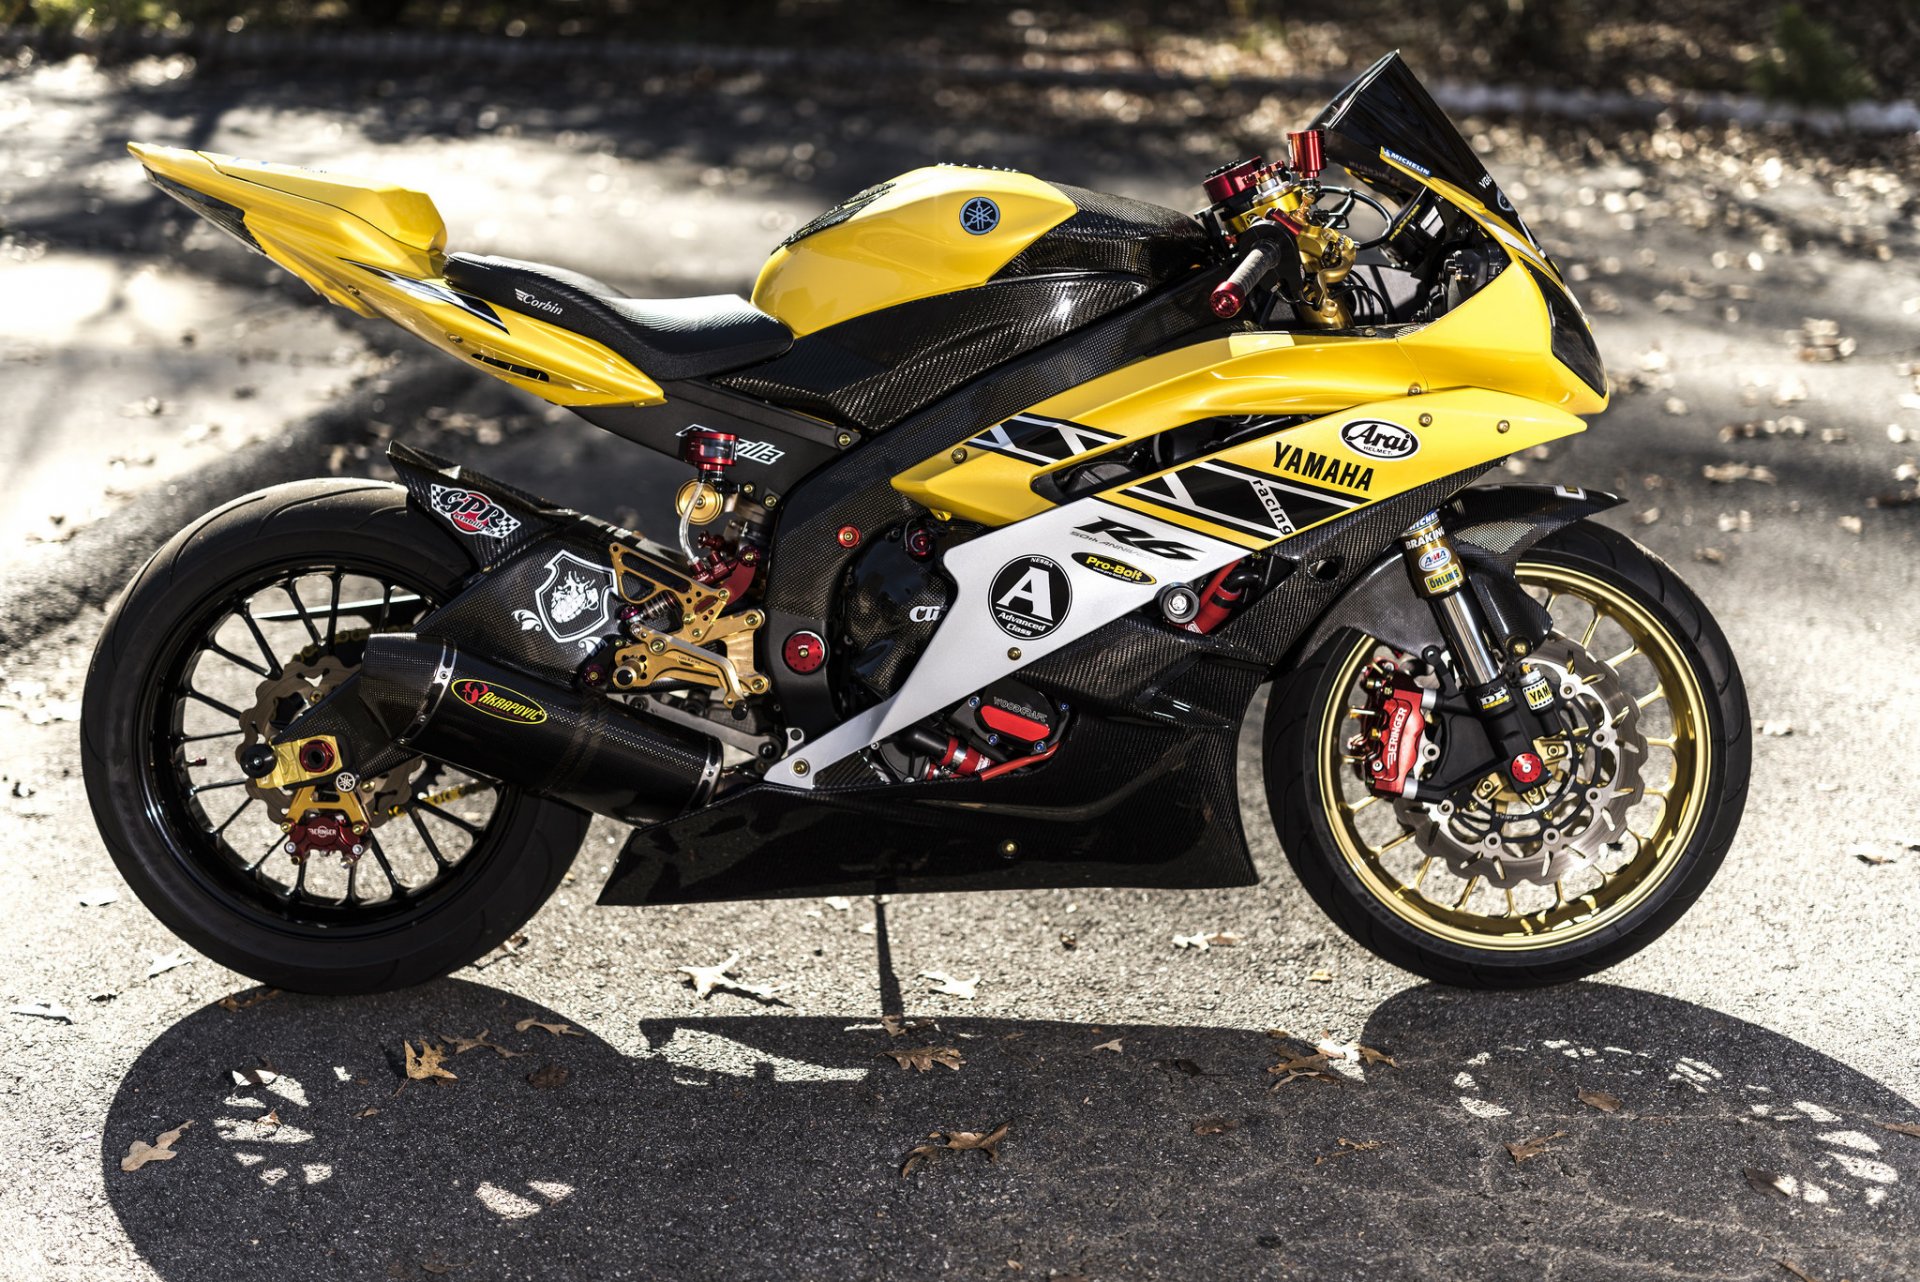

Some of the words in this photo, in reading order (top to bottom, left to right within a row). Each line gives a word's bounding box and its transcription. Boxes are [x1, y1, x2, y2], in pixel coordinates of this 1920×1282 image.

[1390, 152, 1431, 176] MICHELIN
[523, 293, 563, 315] Corbin
[1345, 425, 1412, 452] Arai
[1273, 441, 1374, 491] YAMAHA
[440, 489, 504, 528] GPR
[1252, 479, 1294, 535] racing
[1073, 516, 1207, 561] R6
[1030, 557, 1053, 568] NESBA
[1085, 555, 1143, 581] Pro-Bolt
[1425, 550, 1446, 564] AMA
[996, 566, 1053, 621] A
[997, 611, 1046, 632] Advanced
[1006, 623, 1032, 636] Class
[1387, 707, 1407, 770] BERINGER
